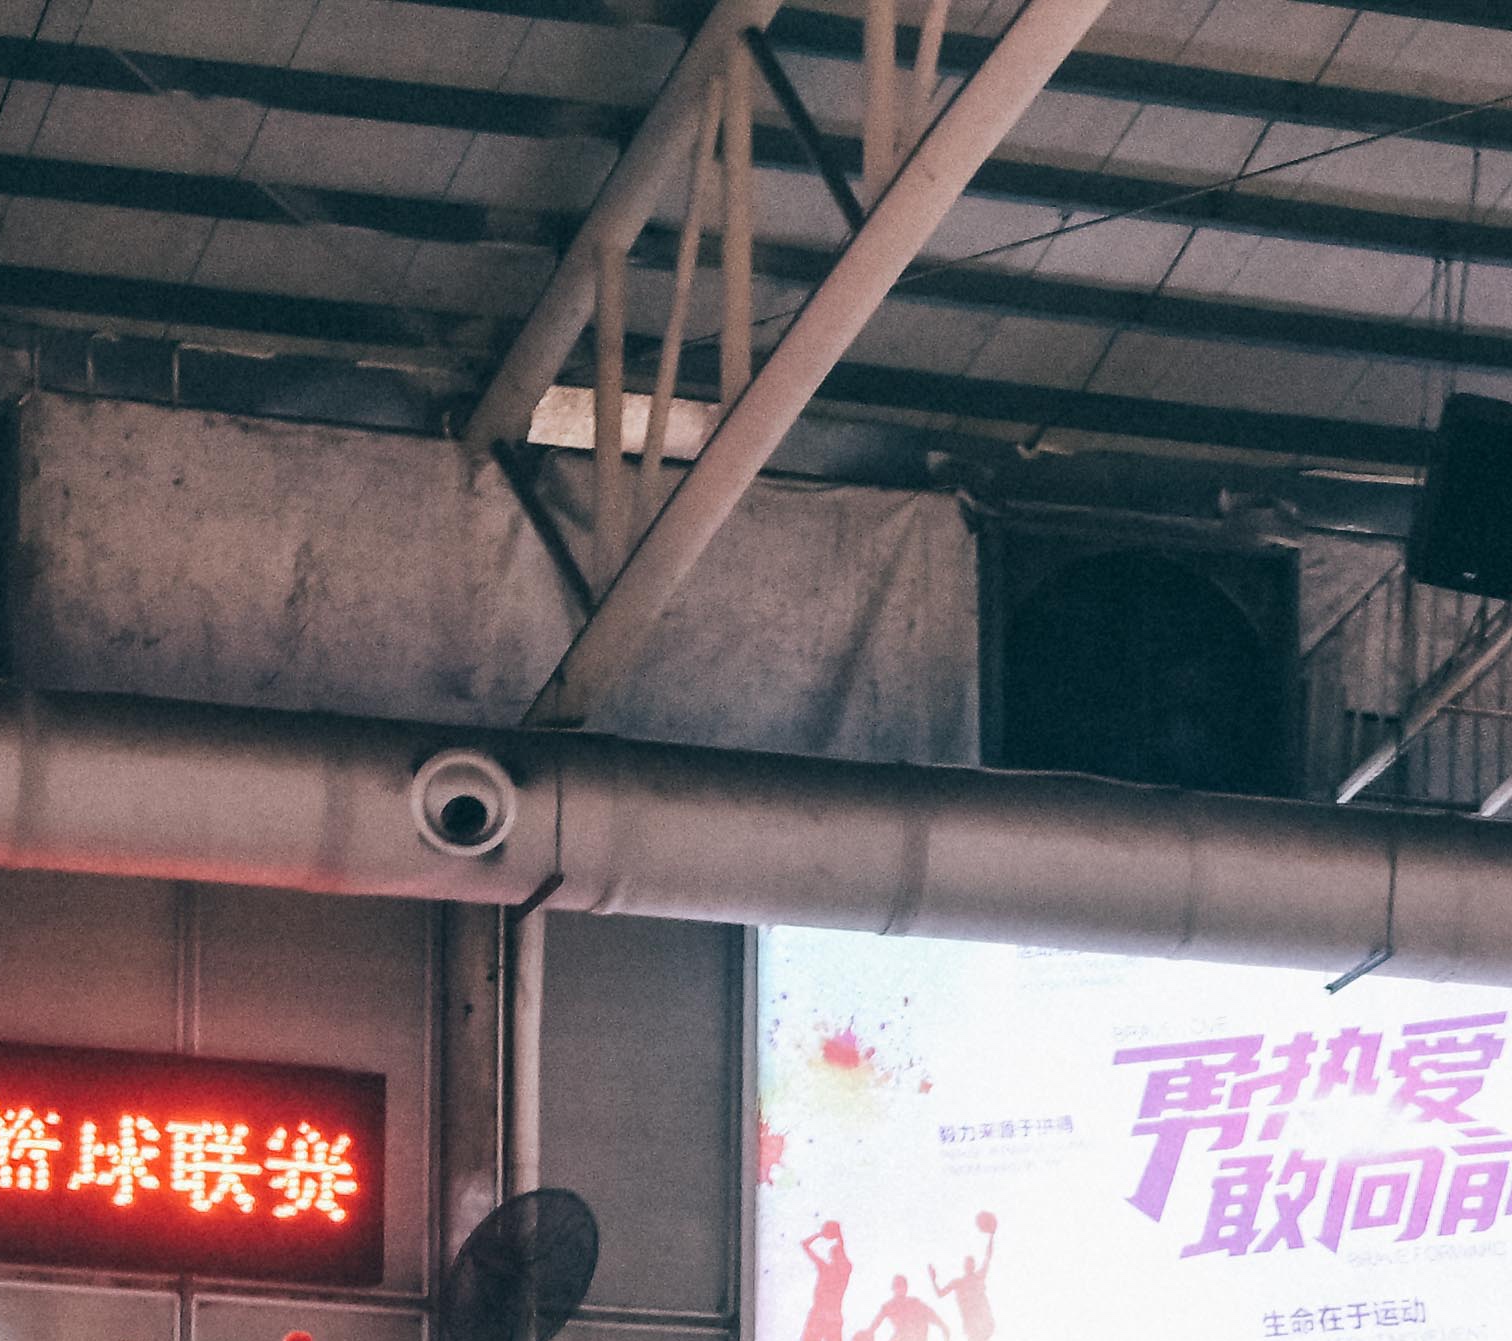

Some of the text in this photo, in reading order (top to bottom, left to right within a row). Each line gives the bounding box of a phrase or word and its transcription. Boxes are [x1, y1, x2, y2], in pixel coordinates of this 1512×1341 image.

[1261, 1297, 1428, 1338] 生命在于运动
